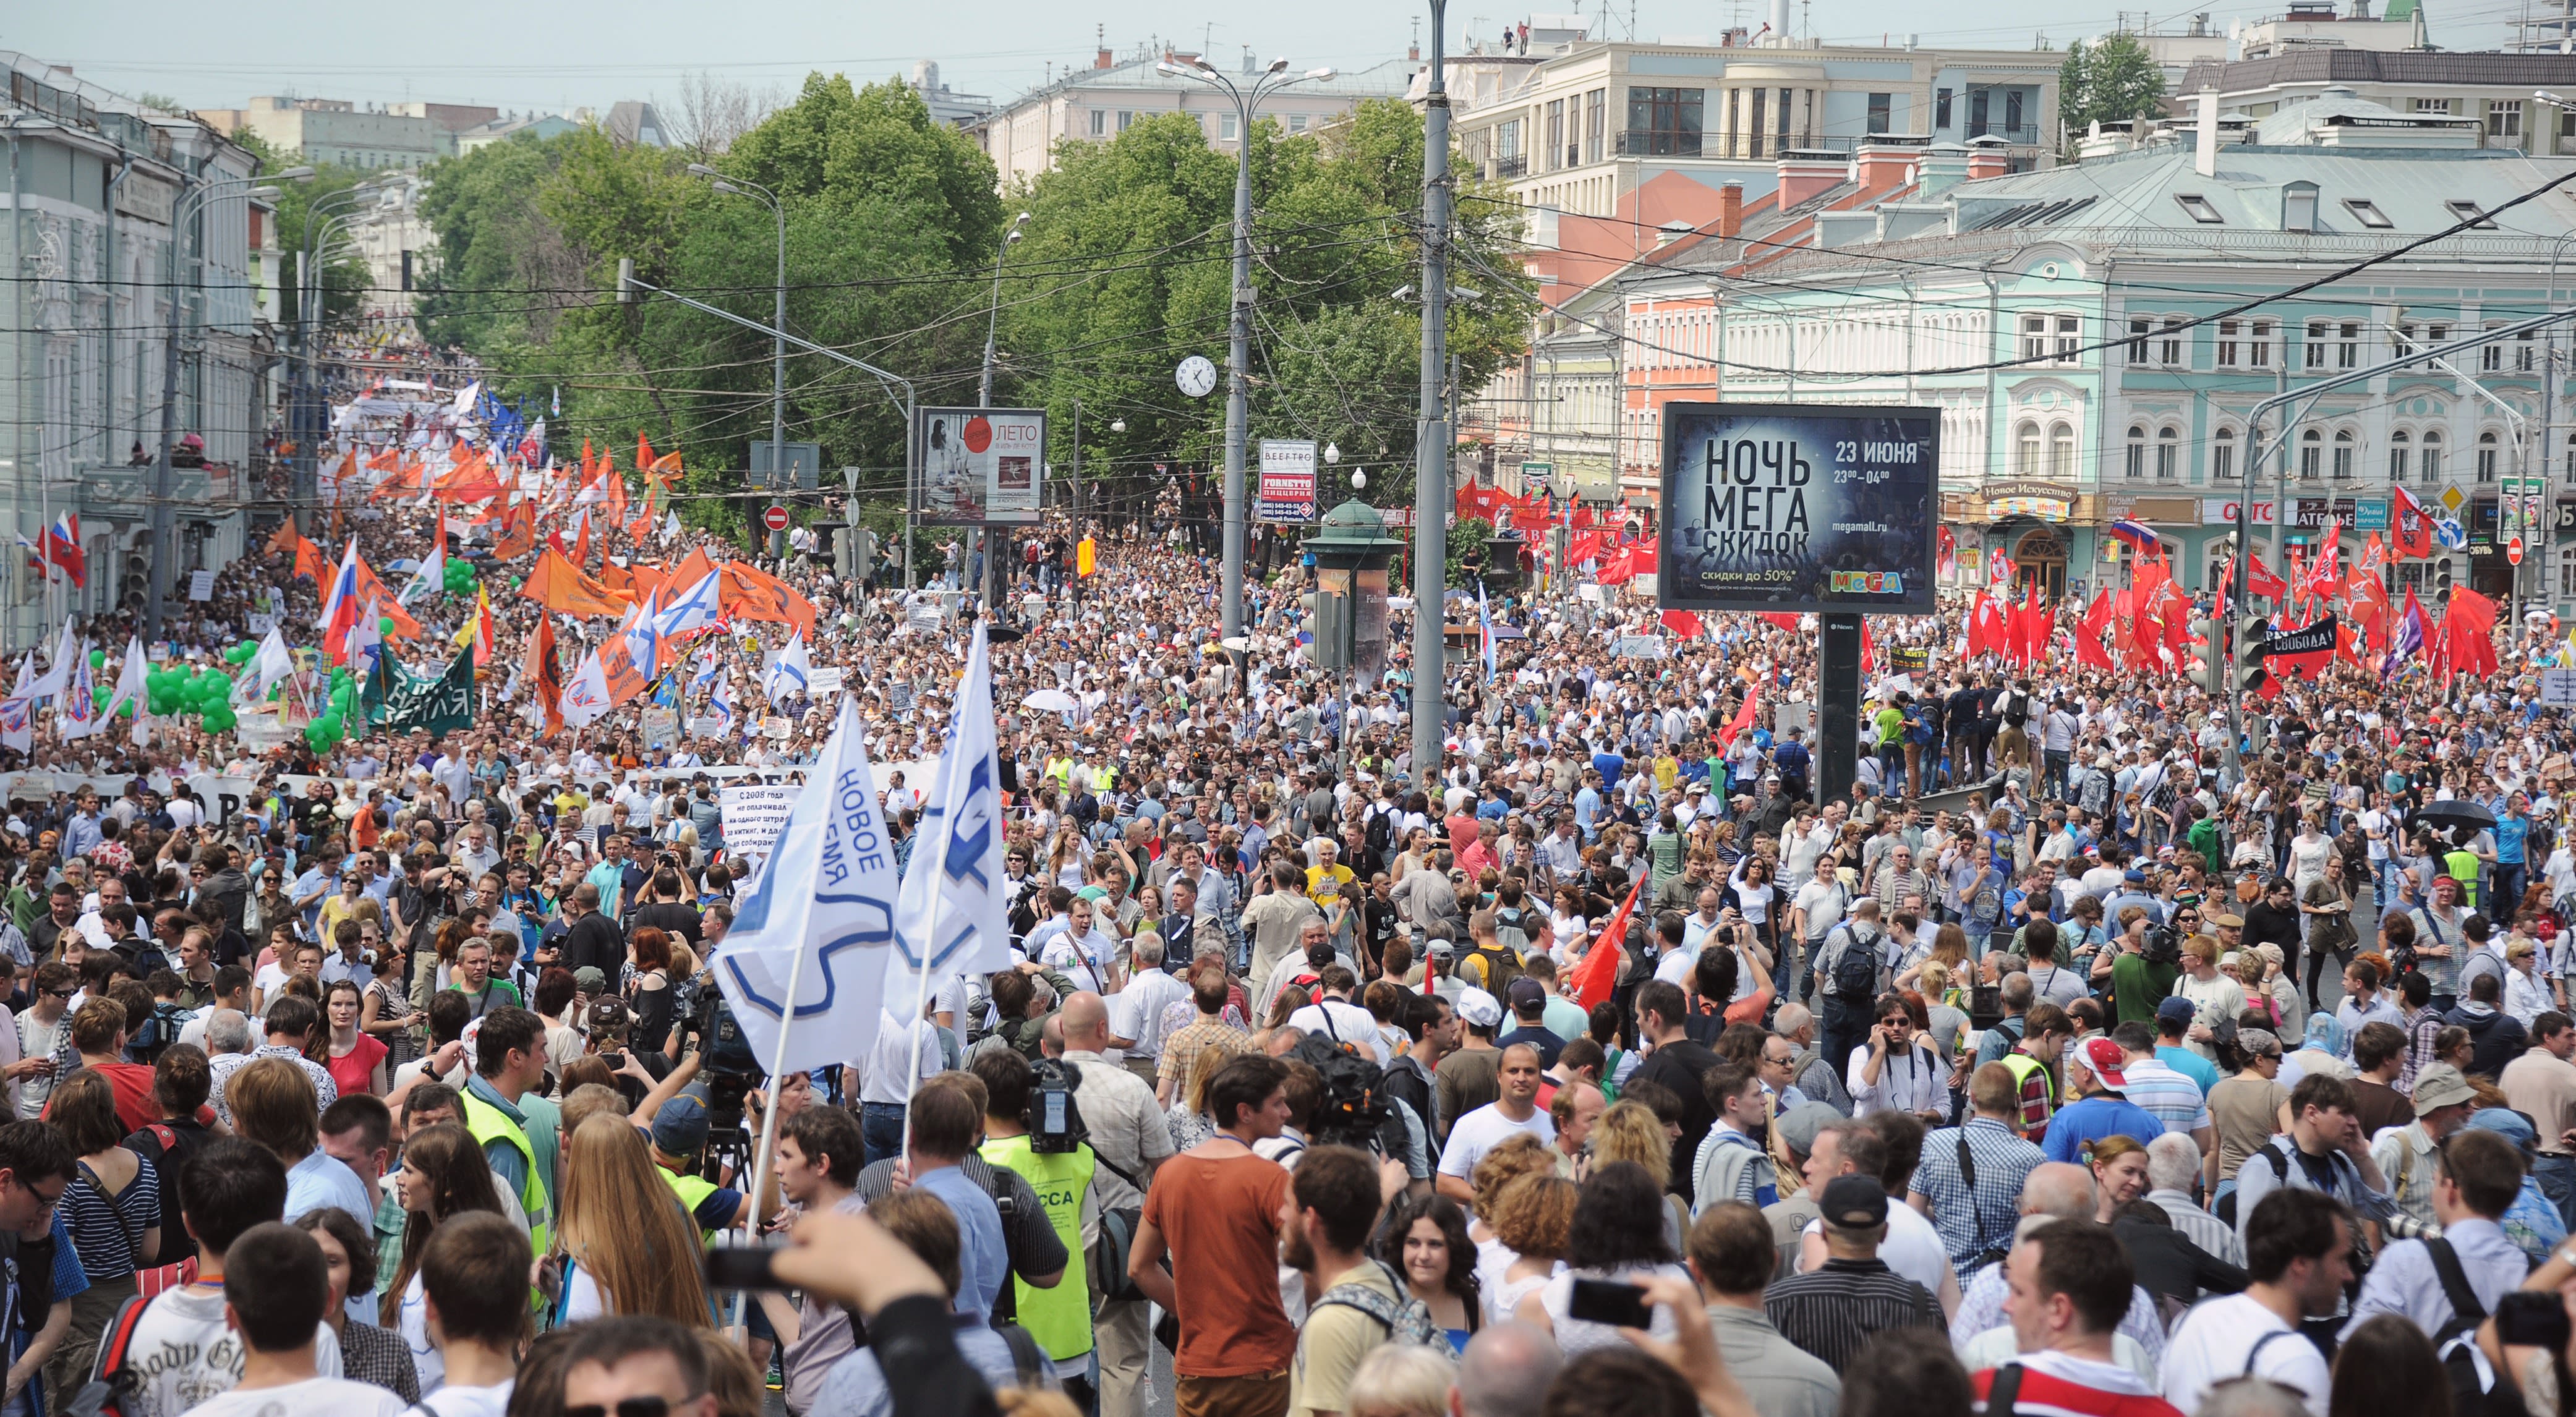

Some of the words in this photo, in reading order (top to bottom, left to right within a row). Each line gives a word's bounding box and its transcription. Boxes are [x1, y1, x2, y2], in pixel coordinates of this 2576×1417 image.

[996, 425, 1037, 441] ЛЕТО
[1265, 452, 1311, 461] BEEFTRO
[1835, 441, 1857, 462] 23
[1864, 441, 1917, 464] ИЮНЯ
[1705, 439, 1810, 486] НОЧЬ
[1264, 478, 1311, 488] FORNETTO
[1985, 486, 2016, 497] Новое
[2018, 483, 2072, 498] Искусство
[2108, 495, 2136, 505] МУЗЫКА
[1704, 485, 1809, 532] МЕГА
[2037, 503, 2066, 513] lifestyle
[2298, 513, 2353, 526] АТЕЬЕ
[1832, 521, 1887, 534] megamall.ru
[1703, 530, 1810, 556] СКИДОК
[2469, 545, 2493, 555] ОБУВЬ
[1701, 571, 1742, 581] скидки
[1745, 572, 1761, 582] до
[1904, 650, 1928, 658] ЖИТЬ
[746, 791, 765, 799] 2008
[838, 768, 885, 874] НОВОЕ
[823, 811, 849, 887] ЕМЯ
[1039, 1191, 1073, 1207] ССА
